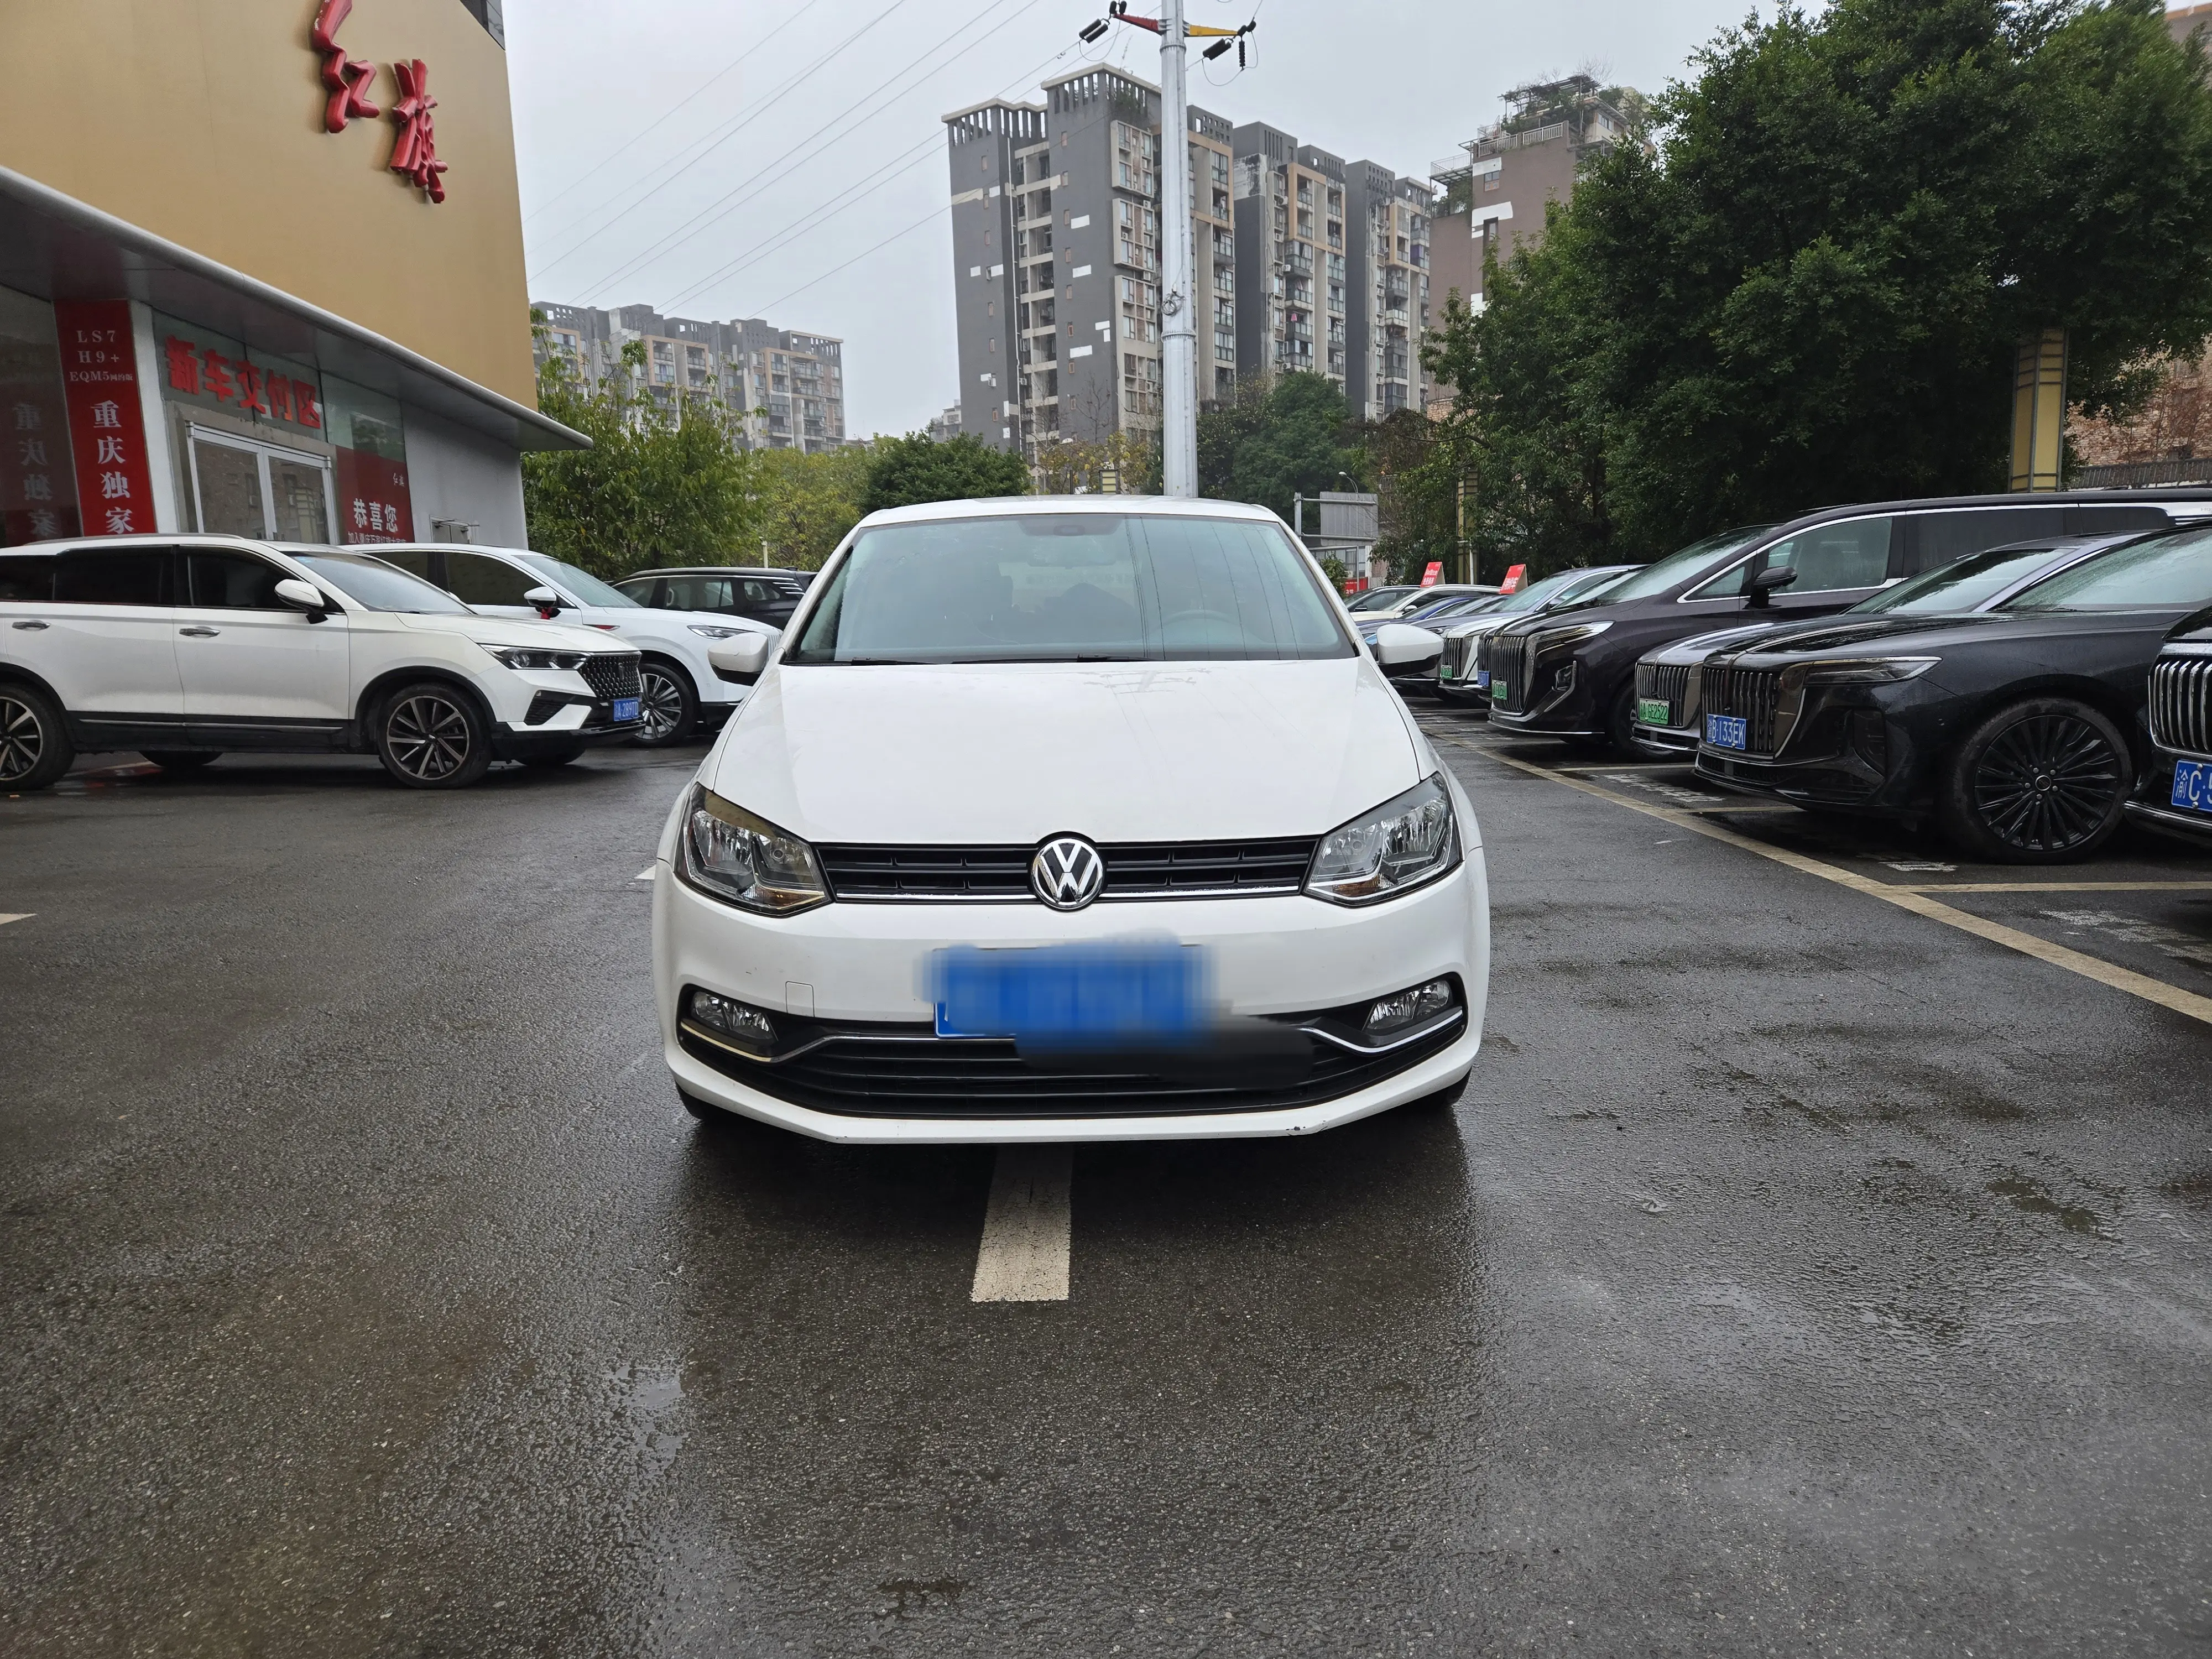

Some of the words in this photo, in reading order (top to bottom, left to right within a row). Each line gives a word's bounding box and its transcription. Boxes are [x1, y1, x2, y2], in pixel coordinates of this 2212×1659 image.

[77, 330, 116, 343] LS7
[78, 350, 119, 363] H9+
[164, 333, 321, 429] 新车交付区
[90, 400, 135, 535] 重庆独家
[353, 498, 399, 533] 恭喜您
